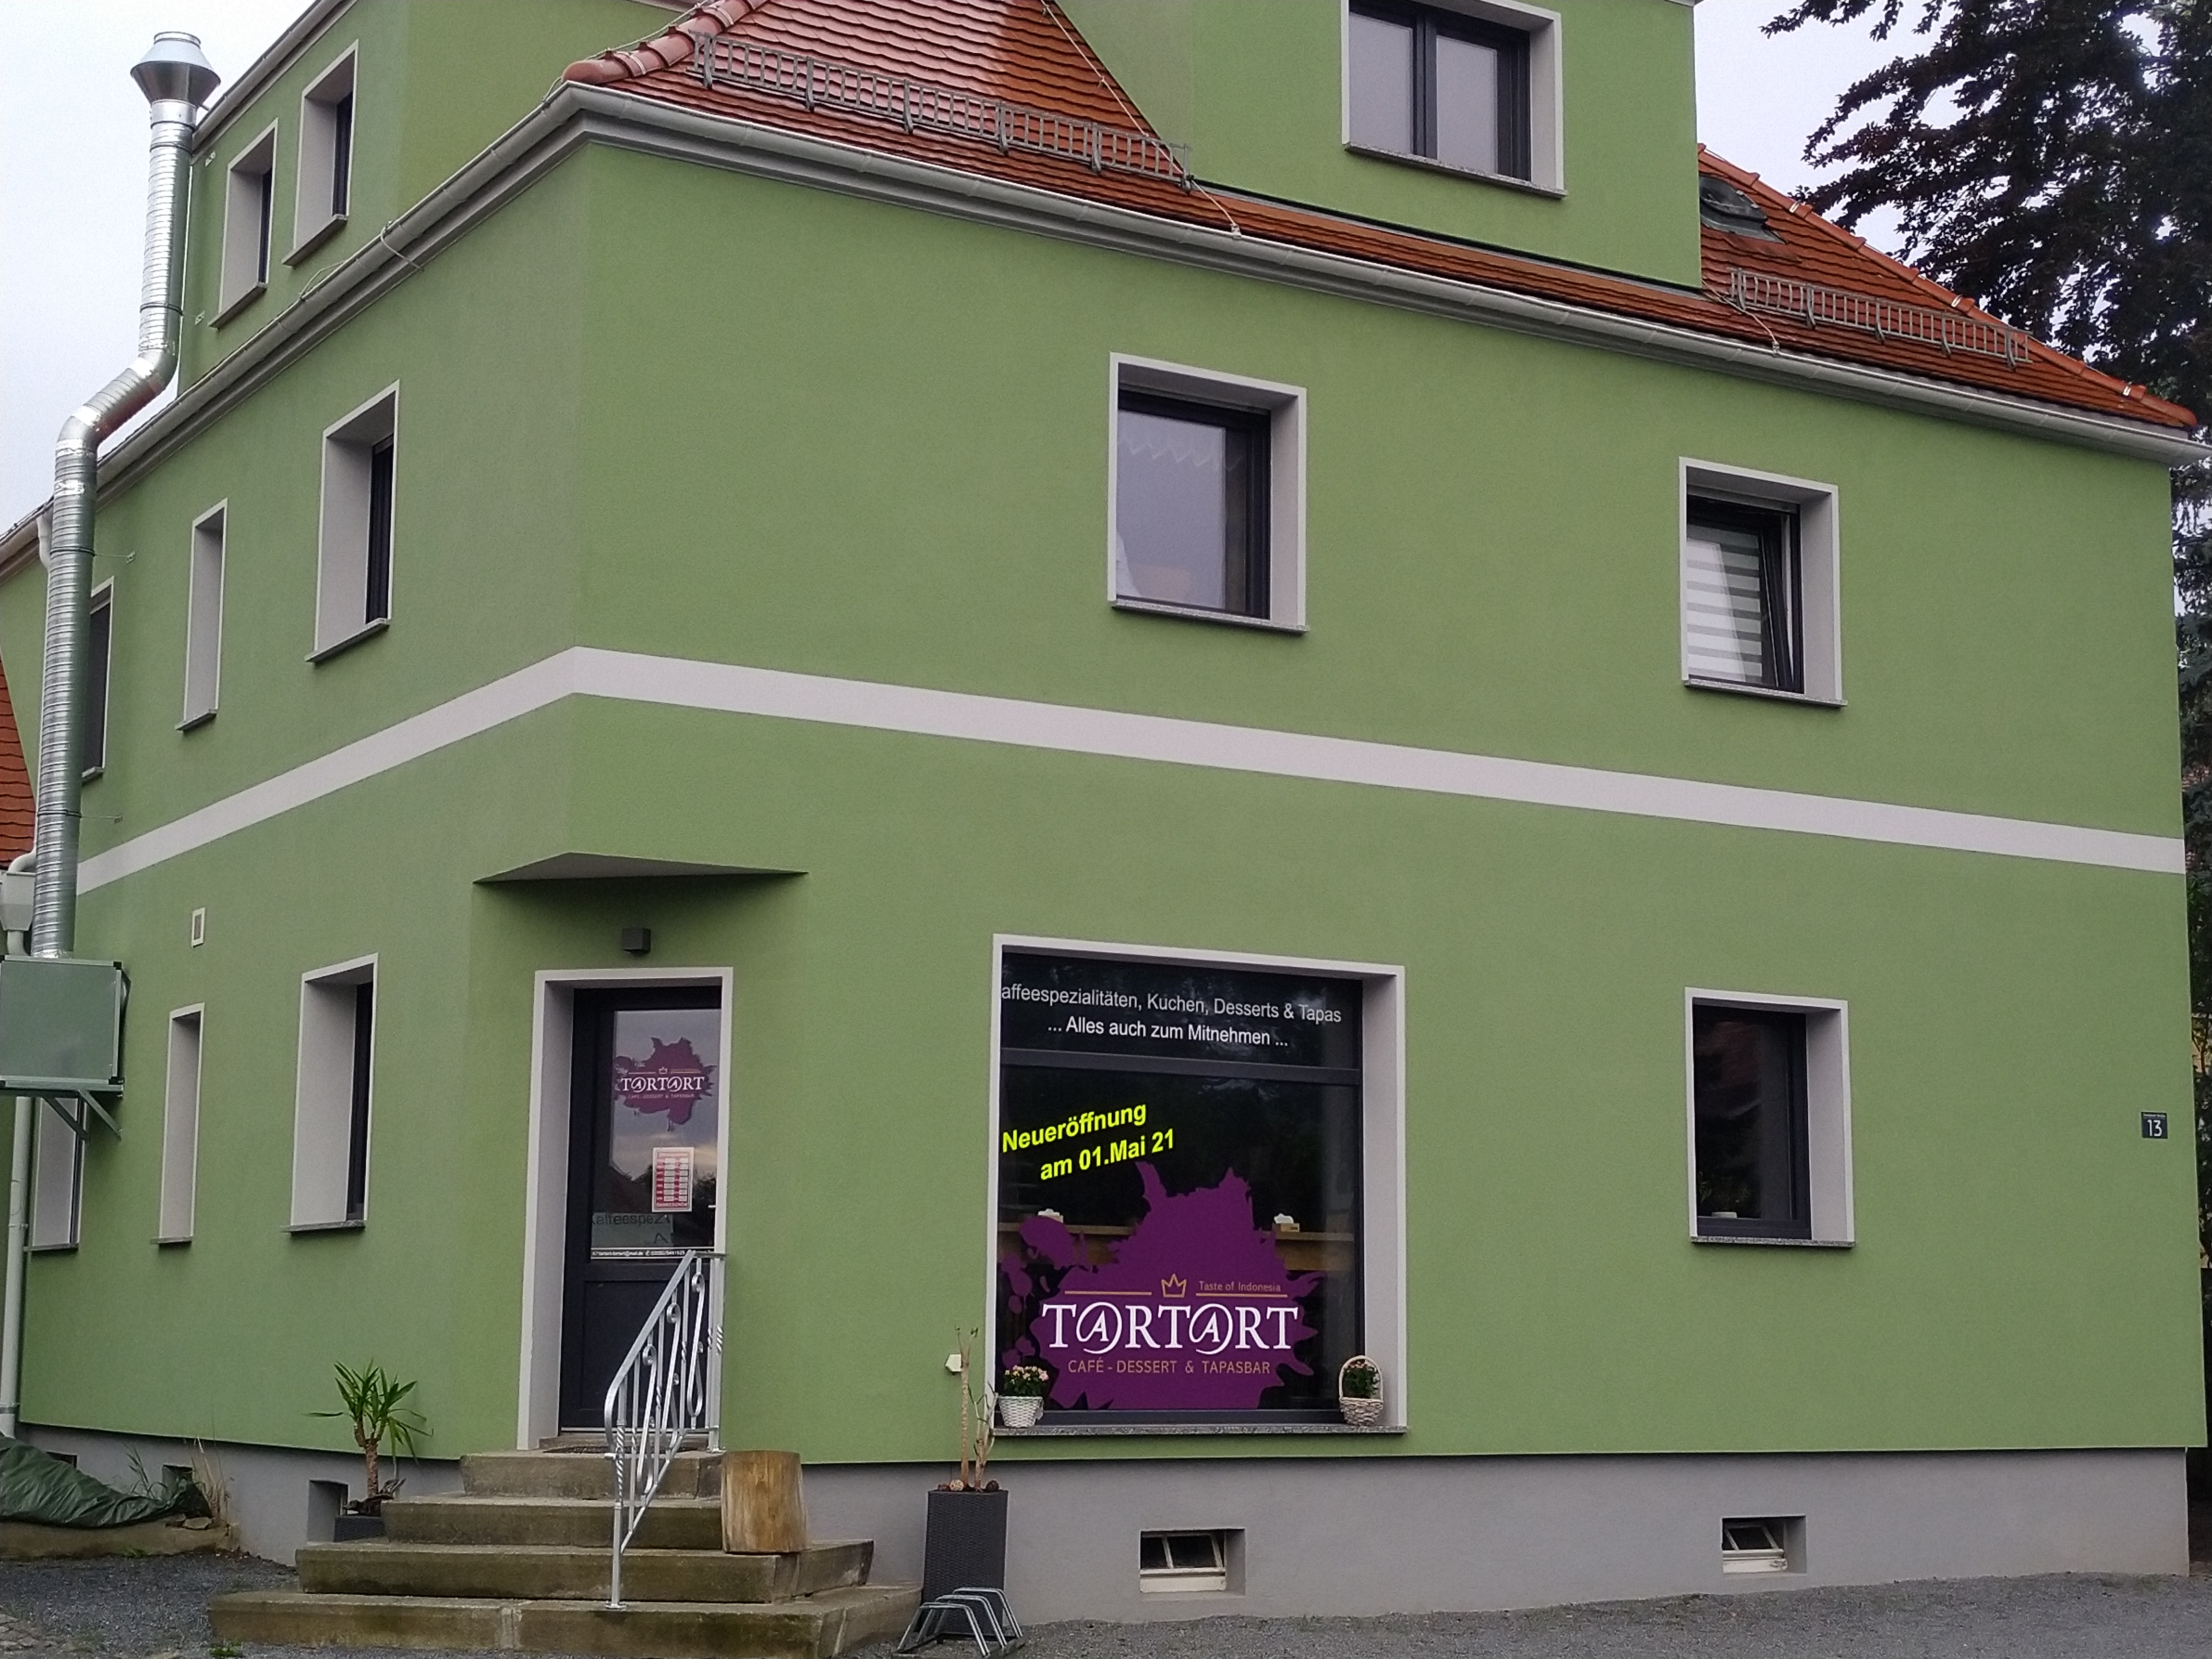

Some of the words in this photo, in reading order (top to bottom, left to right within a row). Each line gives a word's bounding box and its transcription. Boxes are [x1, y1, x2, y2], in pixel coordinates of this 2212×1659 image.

[1001, 984, 1142, 1010] affeespezialitäten,
[1147, 993, 1209, 1015] Kuchen,
[1214, 998, 1279, 1018] Desserts
[1284, 1003, 1294, 1019] &
[1298, 1004, 1341, 1024] Tapas
[1066, 1016, 1104, 1034] Alles
[1109, 1021, 1146, 1037] auch
[1151, 1025, 1183, 1039] zum
[1188, 1024, 1270, 1045] Mitnehmen
[1002, 1104, 1146, 1153] Neueröffnung
[2147, 1119, 2163, 1137] 13
[1041, 1158, 1072, 1180] am
[1079, 1135, 1145, 1170] 01.Mai
[1152, 1128, 1173, 1153] 21
[1199, 1280, 1223, 1291] Taste
[1226, 1281, 1235, 1291] of
[1238, 1281, 1281, 1292] Indonesia
[1068, 1357, 1104, 1373] CAFÉ
[1117, 1360, 1177, 1373] DESSERT
[1185, 1360, 1194, 1373] &
[1202, 1360, 1270, 1374] TAPASBAR
